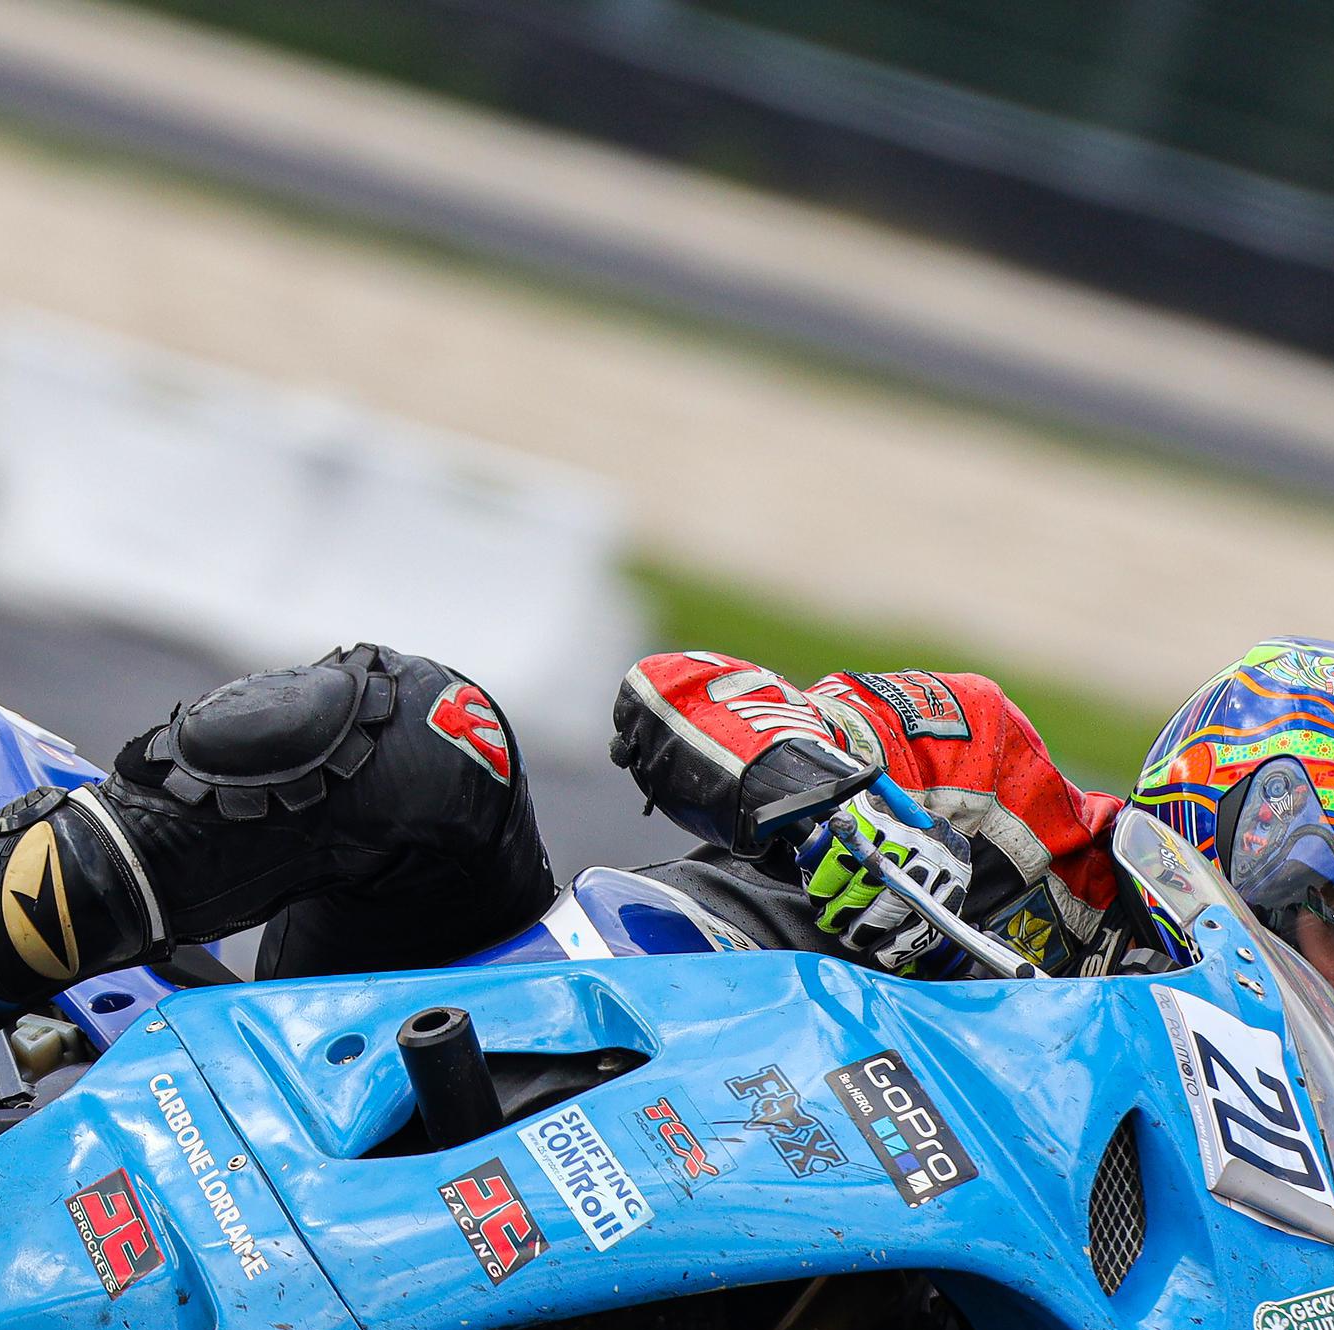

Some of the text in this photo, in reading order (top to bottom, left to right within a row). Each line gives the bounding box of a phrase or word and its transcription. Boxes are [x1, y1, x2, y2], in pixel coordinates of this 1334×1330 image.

[838, 1072, 851, 1085] Be
[863, 1057, 958, 1182] GoPro
[1192, 1030, 1326, 1192] 20
[149, 1073, 270, 1281] CARBONE LORRAINE
[561, 1111, 643, 1221] SHIFTING
[643, 1096, 720, 1179] TCX
[69, 1201, 117, 1294] SPROCKETS
[440, 1186, 504, 1278] RACING
